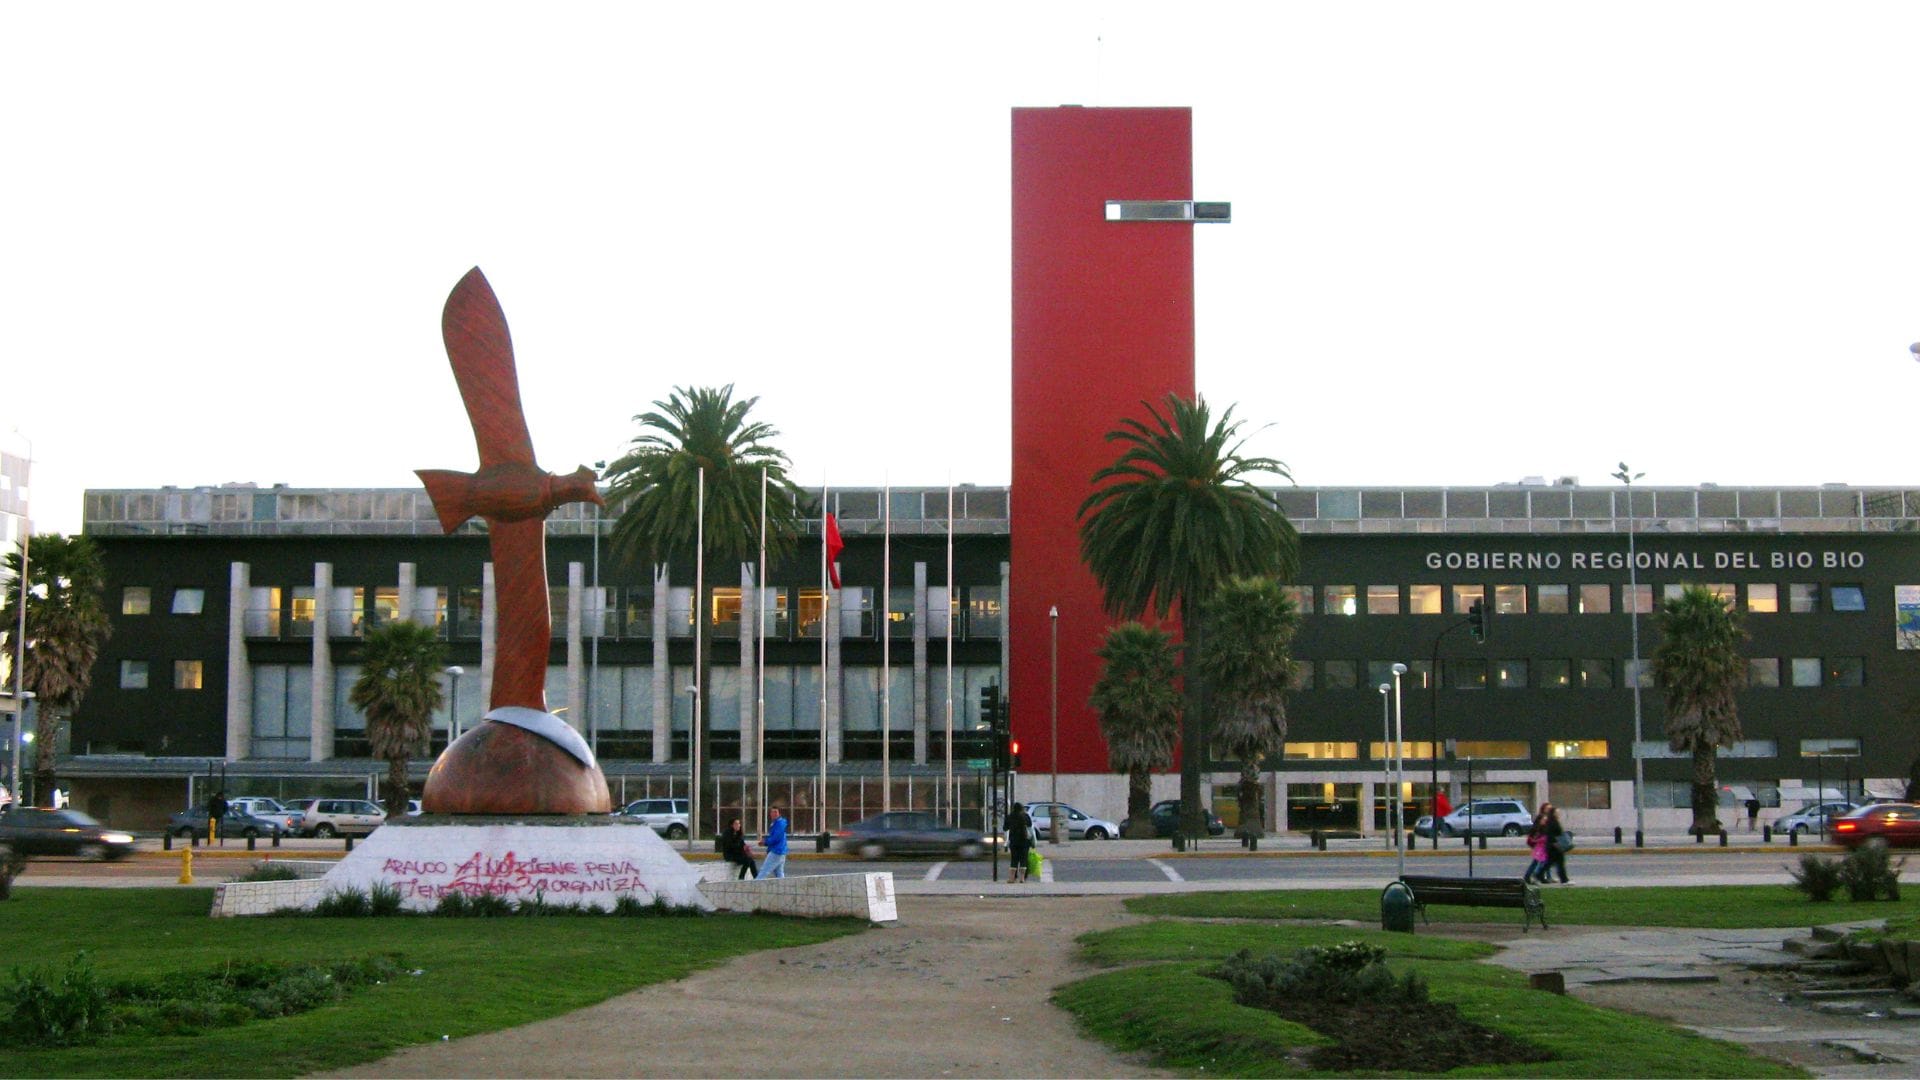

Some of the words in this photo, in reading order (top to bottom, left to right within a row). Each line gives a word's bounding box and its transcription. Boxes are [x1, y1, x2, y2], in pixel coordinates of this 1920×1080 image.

[1426, 552, 1561, 569] GOBIERNO
[1572, 552, 1704, 569] REGIONAL
[1715, 552, 1760, 568] DEL
[1771, 552, 1813, 568] BIO
[1823, 551, 1864, 568] BIO
